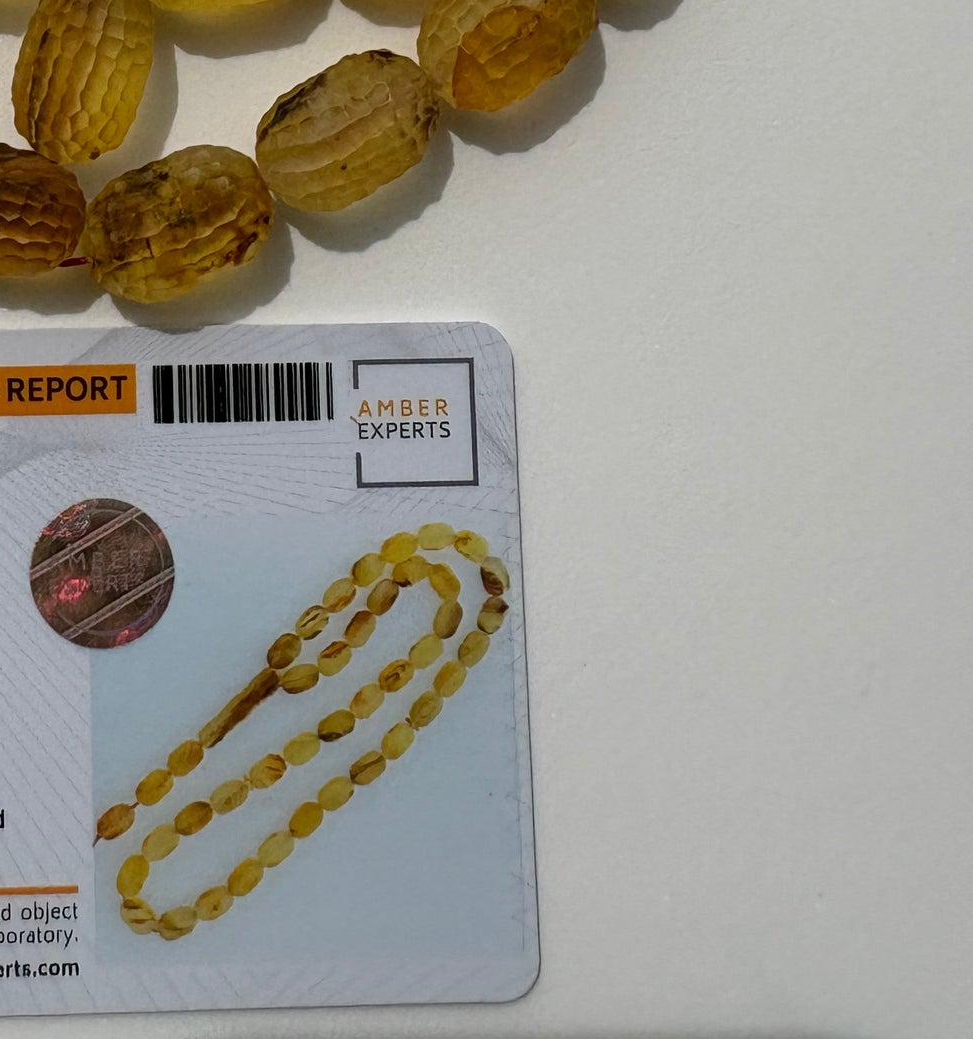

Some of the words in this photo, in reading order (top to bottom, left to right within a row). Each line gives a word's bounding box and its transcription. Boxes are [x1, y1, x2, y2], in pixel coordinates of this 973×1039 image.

[7, 376, 127, 402] REPORT
[358, 399, 449, 417] AMBER
[358, 421, 450, 439] EXPERTS
[20, 902, 78, 926] object
